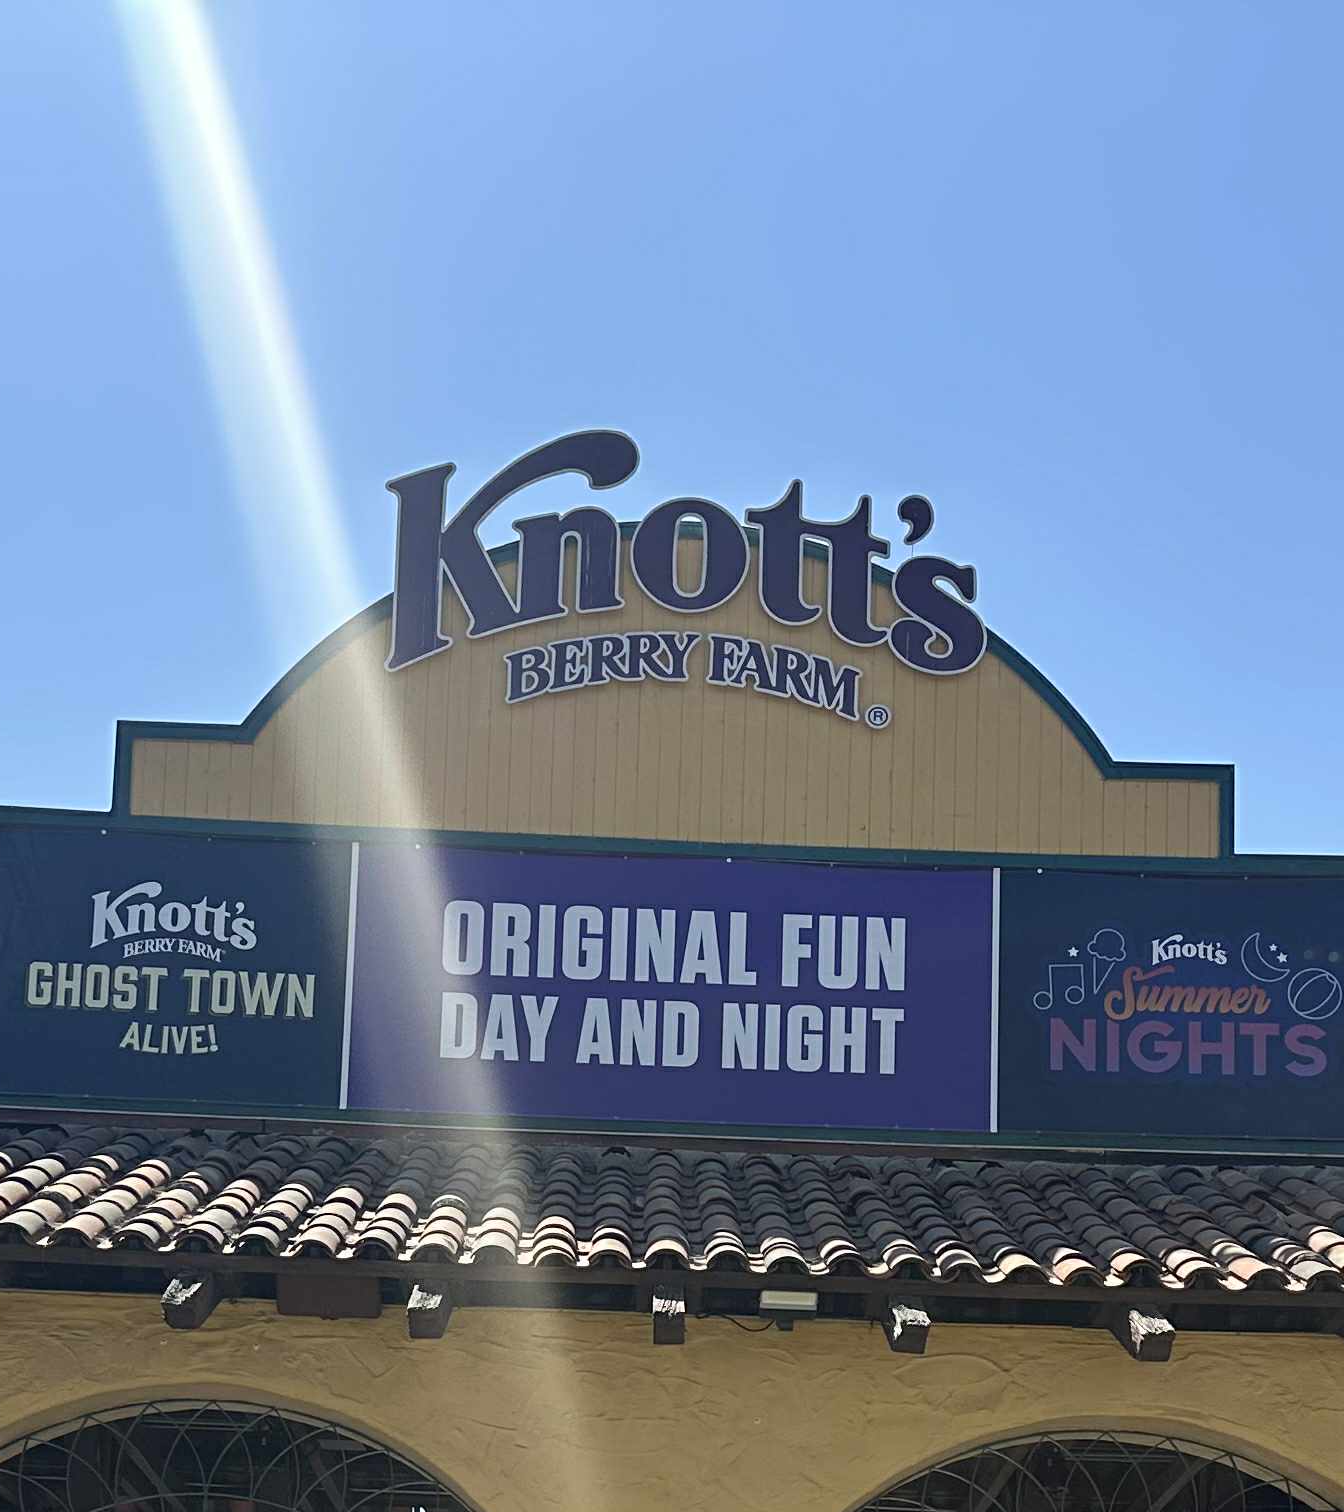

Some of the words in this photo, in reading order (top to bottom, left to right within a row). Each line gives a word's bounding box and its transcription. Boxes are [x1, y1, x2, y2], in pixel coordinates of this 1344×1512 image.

[385, 428, 987, 675] Knott's
[504, 632, 701, 703] BERRY
[707, 632, 863, 722] FARM
[89, 881, 258, 950] Knott's
[441, 900, 757, 986] ORIGINAL
[781, 913, 907, 991] FUN
[122, 938, 175, 960] BERRY
[178, 938, 223, 963] FARM
[1151, 934, 1228, 966] Knott's
[24, 961, 169, 1012] GHOST
[183, 968, 317, 1019] TOWN
[1104, 965, 1272, 1021] Summer
[119, 1021, 219, 1055] ALIVE!
[439, 991, 560, 1063] DAY
[575, 997, 701, 1068] AND
[721, 1002, 906, 1075] NIGHT
[1049, 1017, 1329, 1078] NIGHTS
